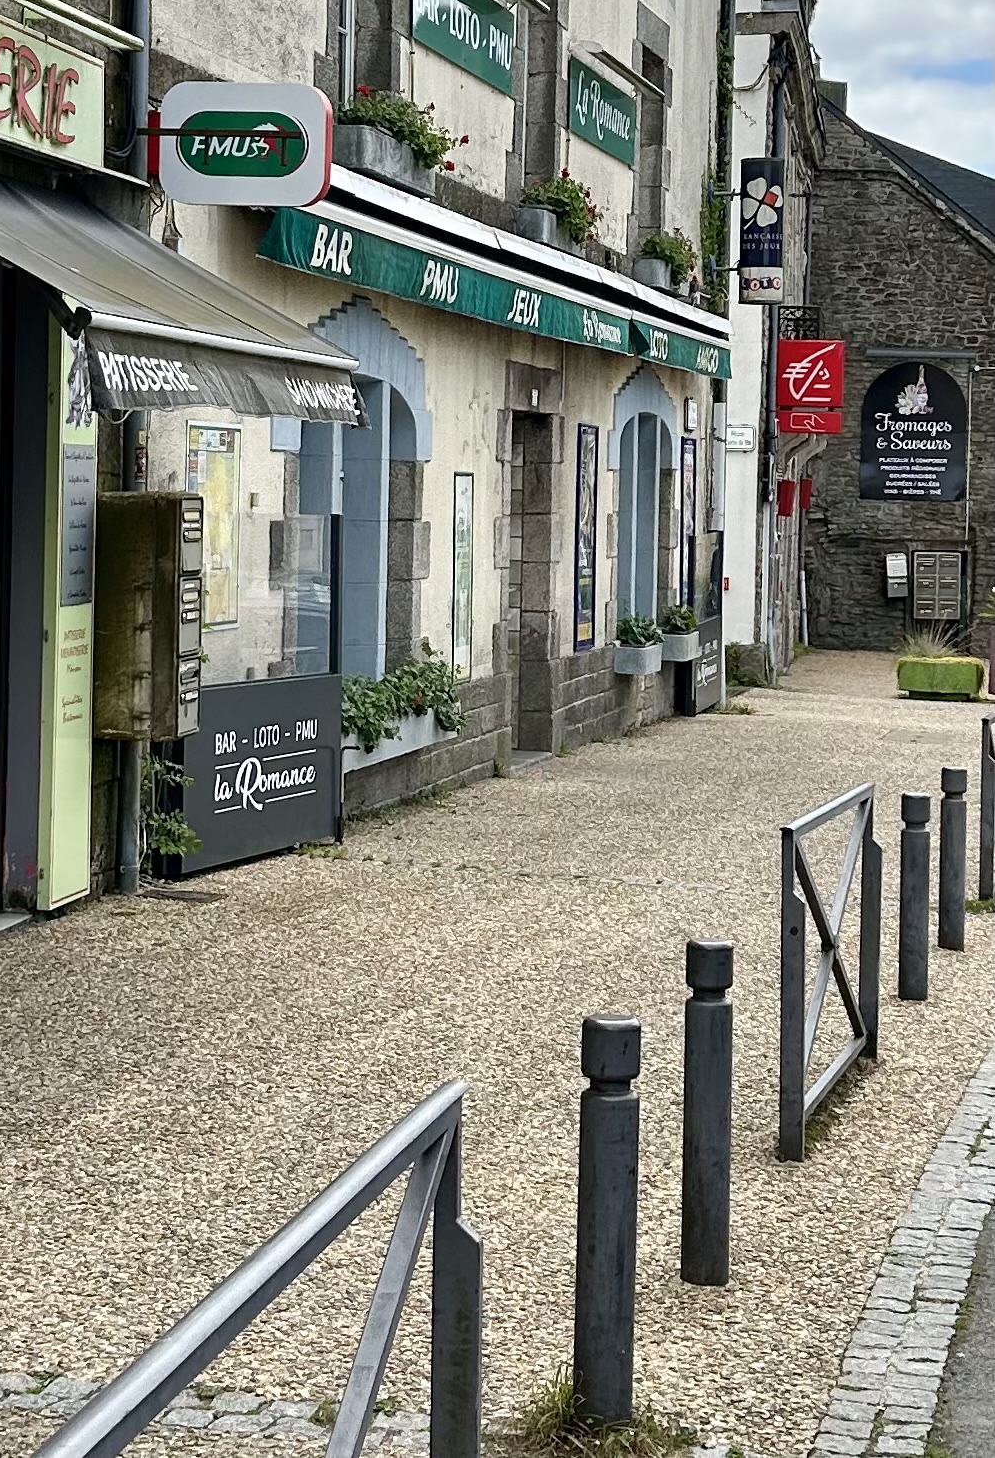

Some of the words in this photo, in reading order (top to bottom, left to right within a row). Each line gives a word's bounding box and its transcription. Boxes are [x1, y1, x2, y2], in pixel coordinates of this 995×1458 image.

[449, 0, 482, 51] LOTO
[488, 23, 514, 72] PMU
[575, 69, 589, 126] La
[590, 78, 631, 141] Romance
[310, 223, 354, 276] BAR
[420, 259, 460, 304] PMU
[741, 276, 782, 292] LOTO
[507, 288, 543, 328] JEUX
[649, 328, 669, 361] LOTO
[97, 350, 199, 393] PATISSERIE
[874, 412, 953, 437] Fromages
[876, 437, 888, 450] &
[890, 430, 953, 451] Saveurs
[214, 730, 237, 755] BAR
[253, 724, 281, 749] LOTO
[295, 718, 318, 742] PMU
[214, 773, 234, 802] la
[235, 756, 318, 811] Romance
